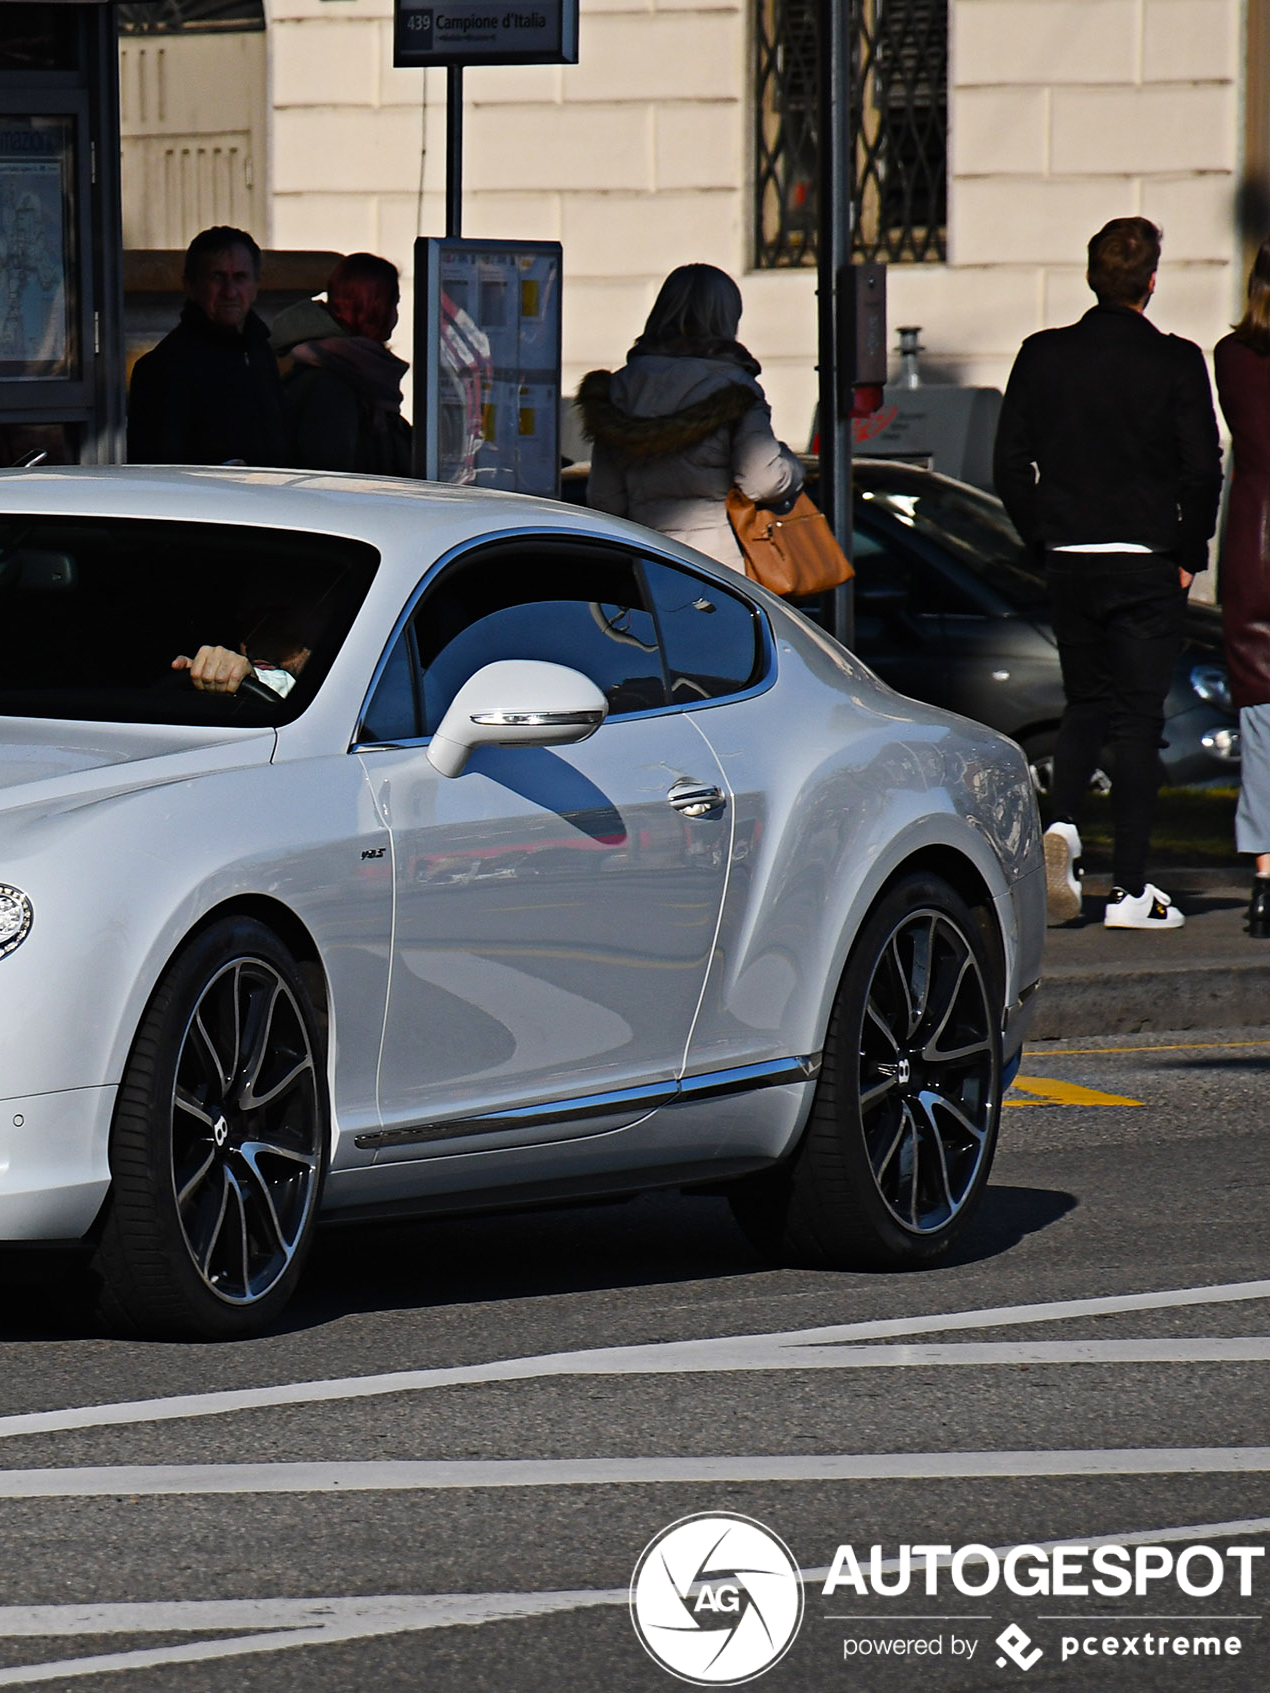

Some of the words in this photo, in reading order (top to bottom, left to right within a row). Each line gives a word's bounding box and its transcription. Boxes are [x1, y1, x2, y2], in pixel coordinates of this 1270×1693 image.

[407, 15, 431, 30] 439
[436, 14, 498, 33] Campione
[503, 13, 546, 29] d'Italia
